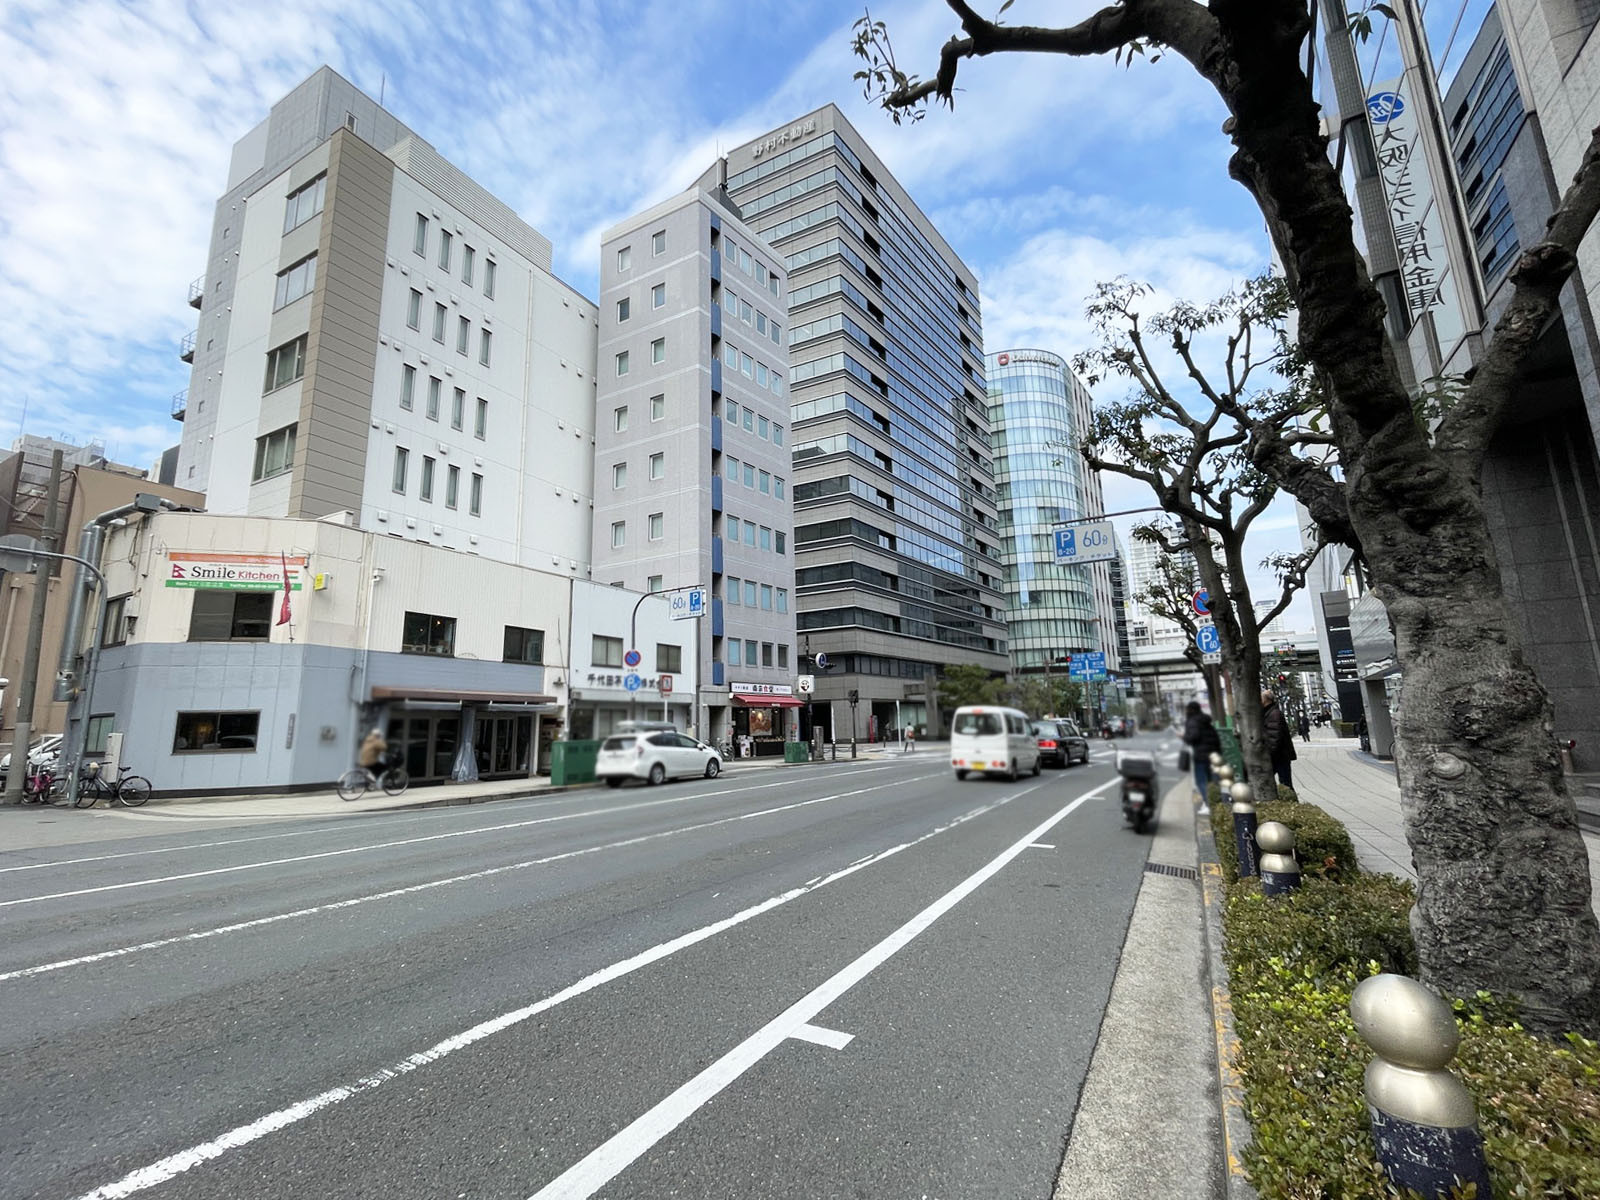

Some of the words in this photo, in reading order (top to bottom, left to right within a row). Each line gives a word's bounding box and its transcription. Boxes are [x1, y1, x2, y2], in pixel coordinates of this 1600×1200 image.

[1060, 532, 1071, 547] P
[191, 566, 236, 579] Smile
[238, 571, 280, 581] Kitchen
[692, 592, 700, 605] P
[1201, 632, 1212, 650] P
